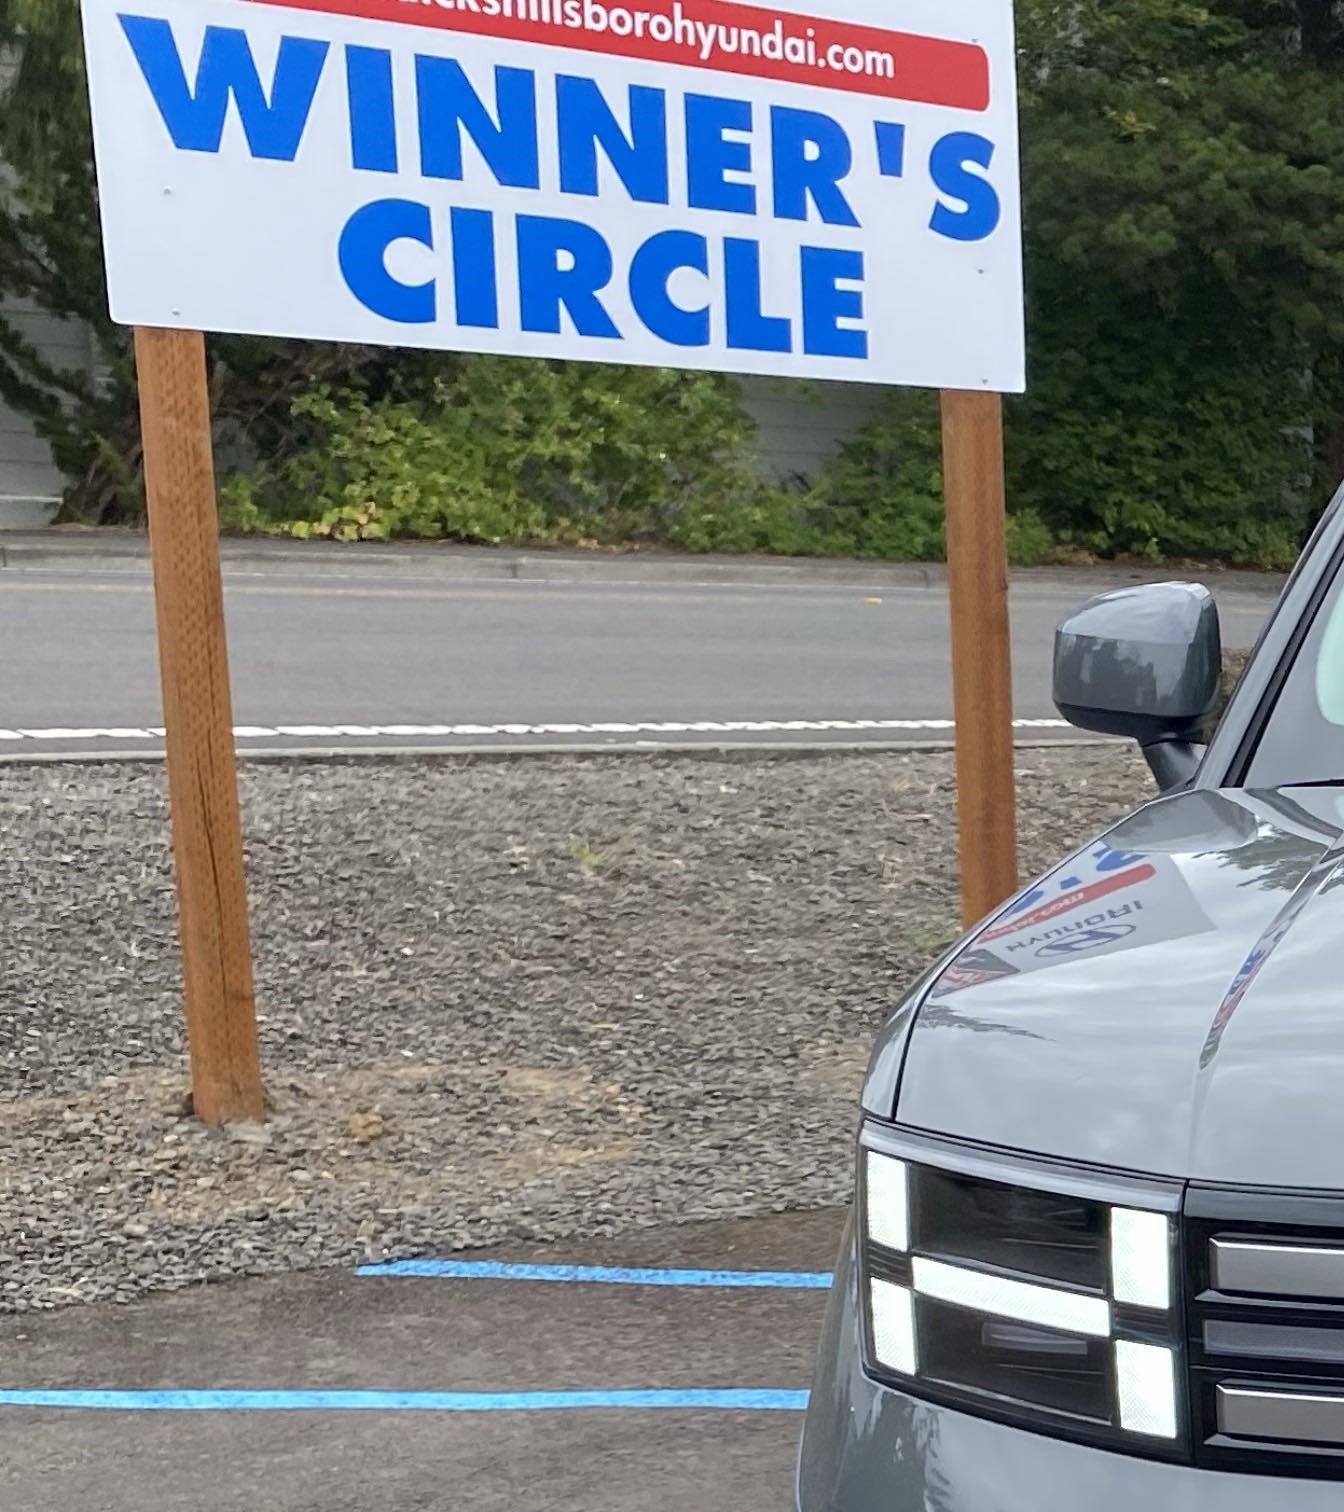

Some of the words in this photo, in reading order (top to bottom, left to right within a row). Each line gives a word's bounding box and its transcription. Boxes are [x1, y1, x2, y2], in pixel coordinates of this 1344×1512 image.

[399, 0, 895, 78] shillsborohyundai.com
[118, 12, 1001, 242] WINNER'S
[337, 197, 869, 360] CIRCLE
